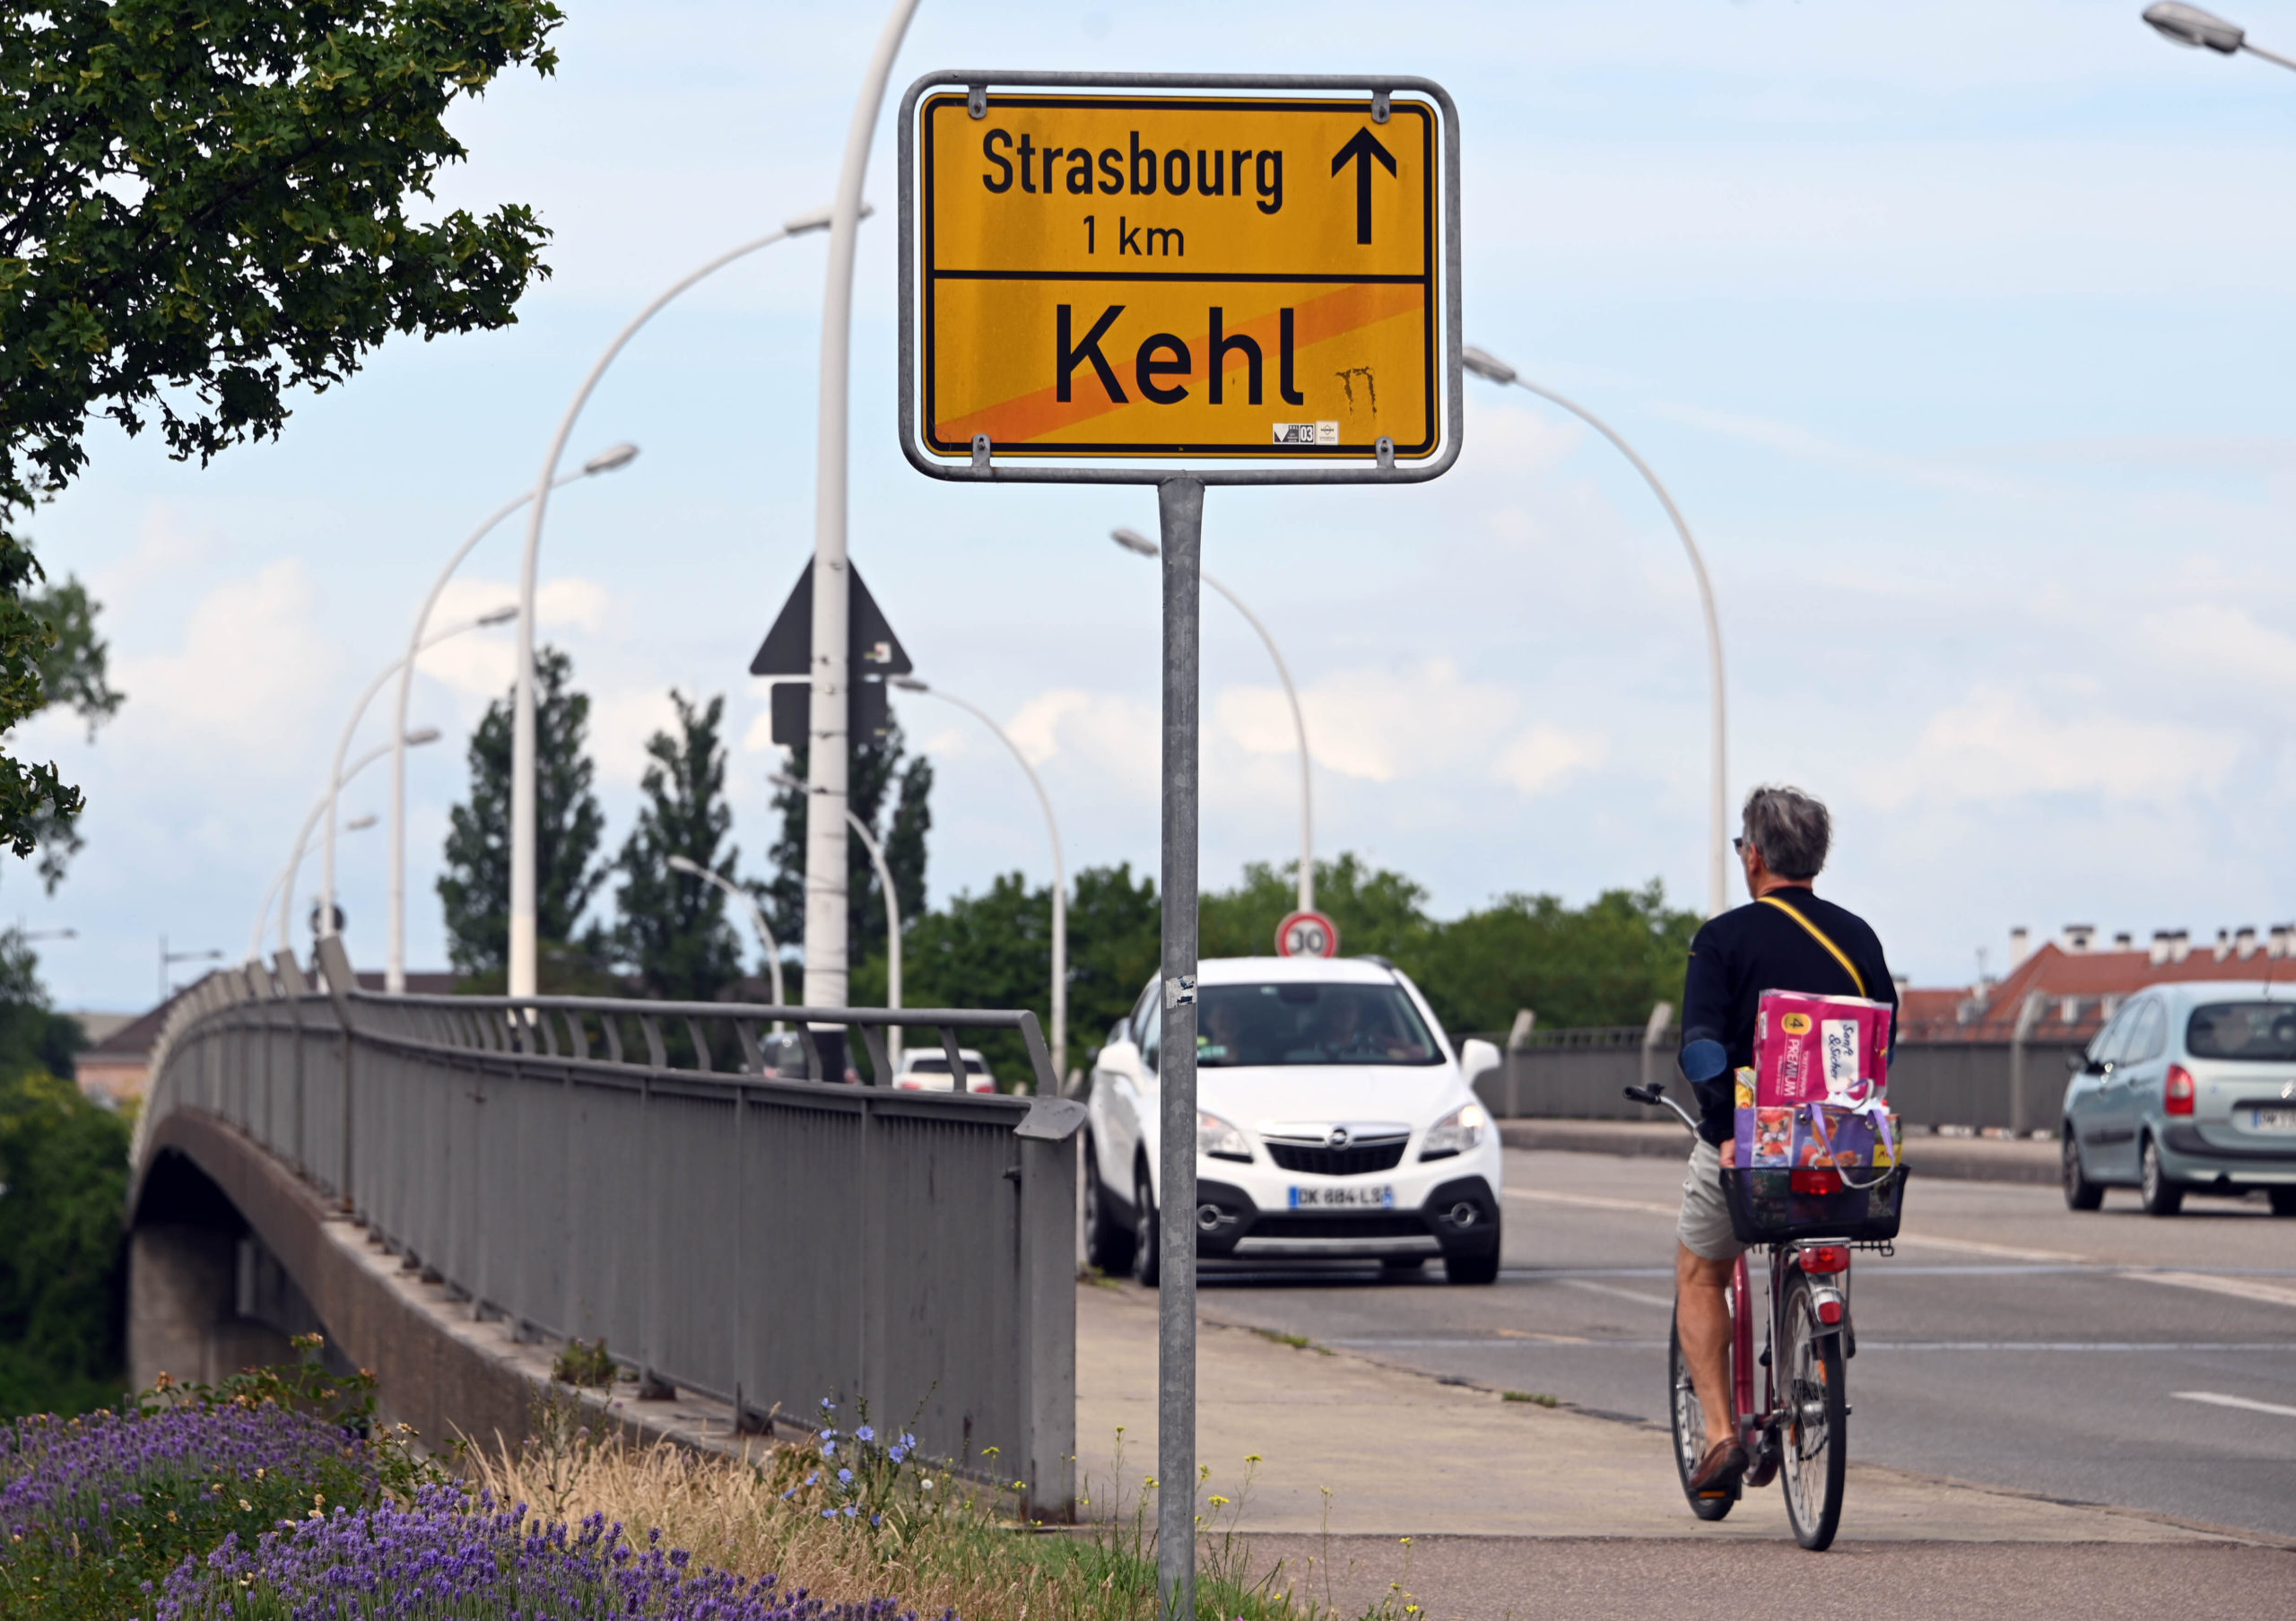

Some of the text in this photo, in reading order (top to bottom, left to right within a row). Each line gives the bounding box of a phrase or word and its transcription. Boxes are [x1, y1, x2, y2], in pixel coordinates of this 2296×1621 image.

[982, 128, 1283, 214] Strasbourg
[1083, 215, 1184, 257] 1 km
[1056, 304, 1304, 405] Kehl
[1300, 426, 1313, 441] 03
[1289, 928, 1325, 954] 30
[1789, 1018, 1805, 1028] 4
[1842, 1024, 1854, 1056] Sanft
[1784, 1039, 1800, 1097] PREMIUM
